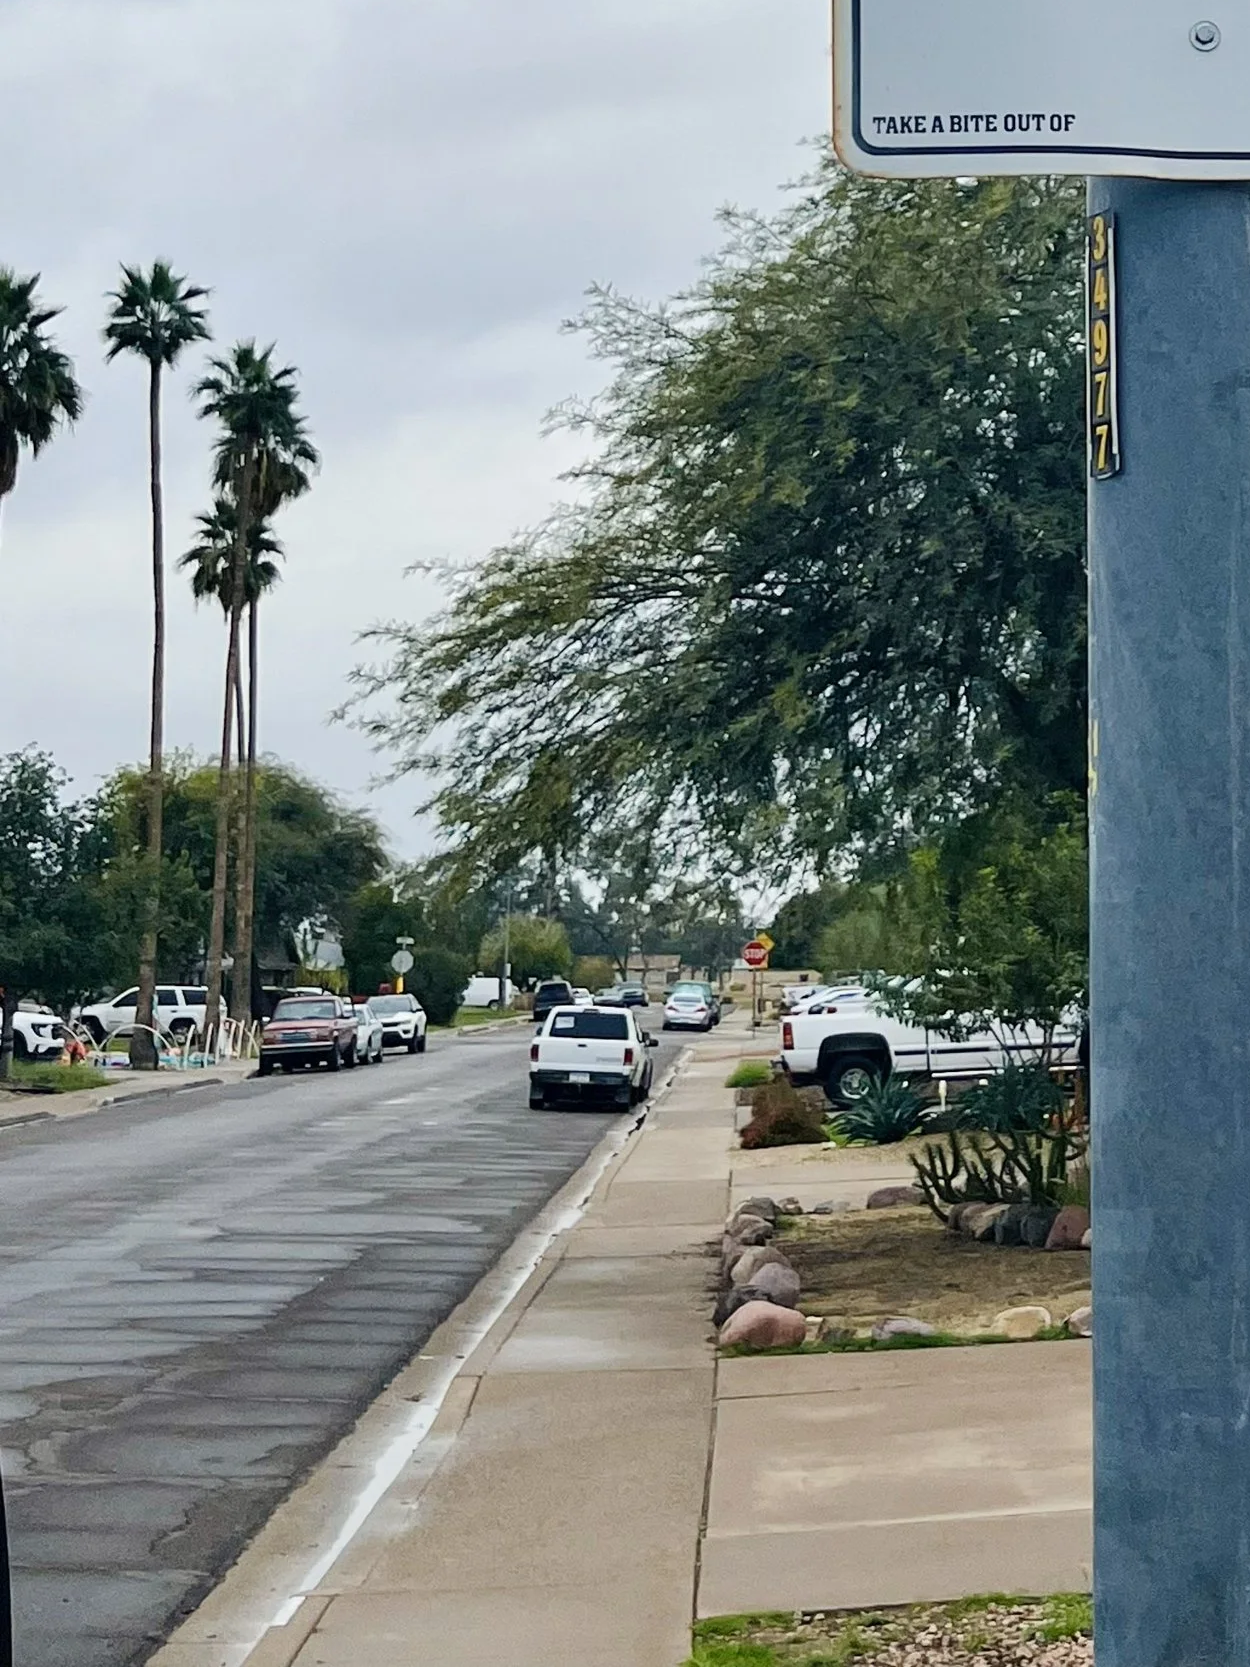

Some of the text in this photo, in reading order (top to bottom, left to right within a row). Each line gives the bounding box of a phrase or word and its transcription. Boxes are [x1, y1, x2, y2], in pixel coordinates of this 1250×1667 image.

[872, 114, 1076, 134] TAKE A BITE OUT OF
[1092, 215, 1109, 470] 34977
